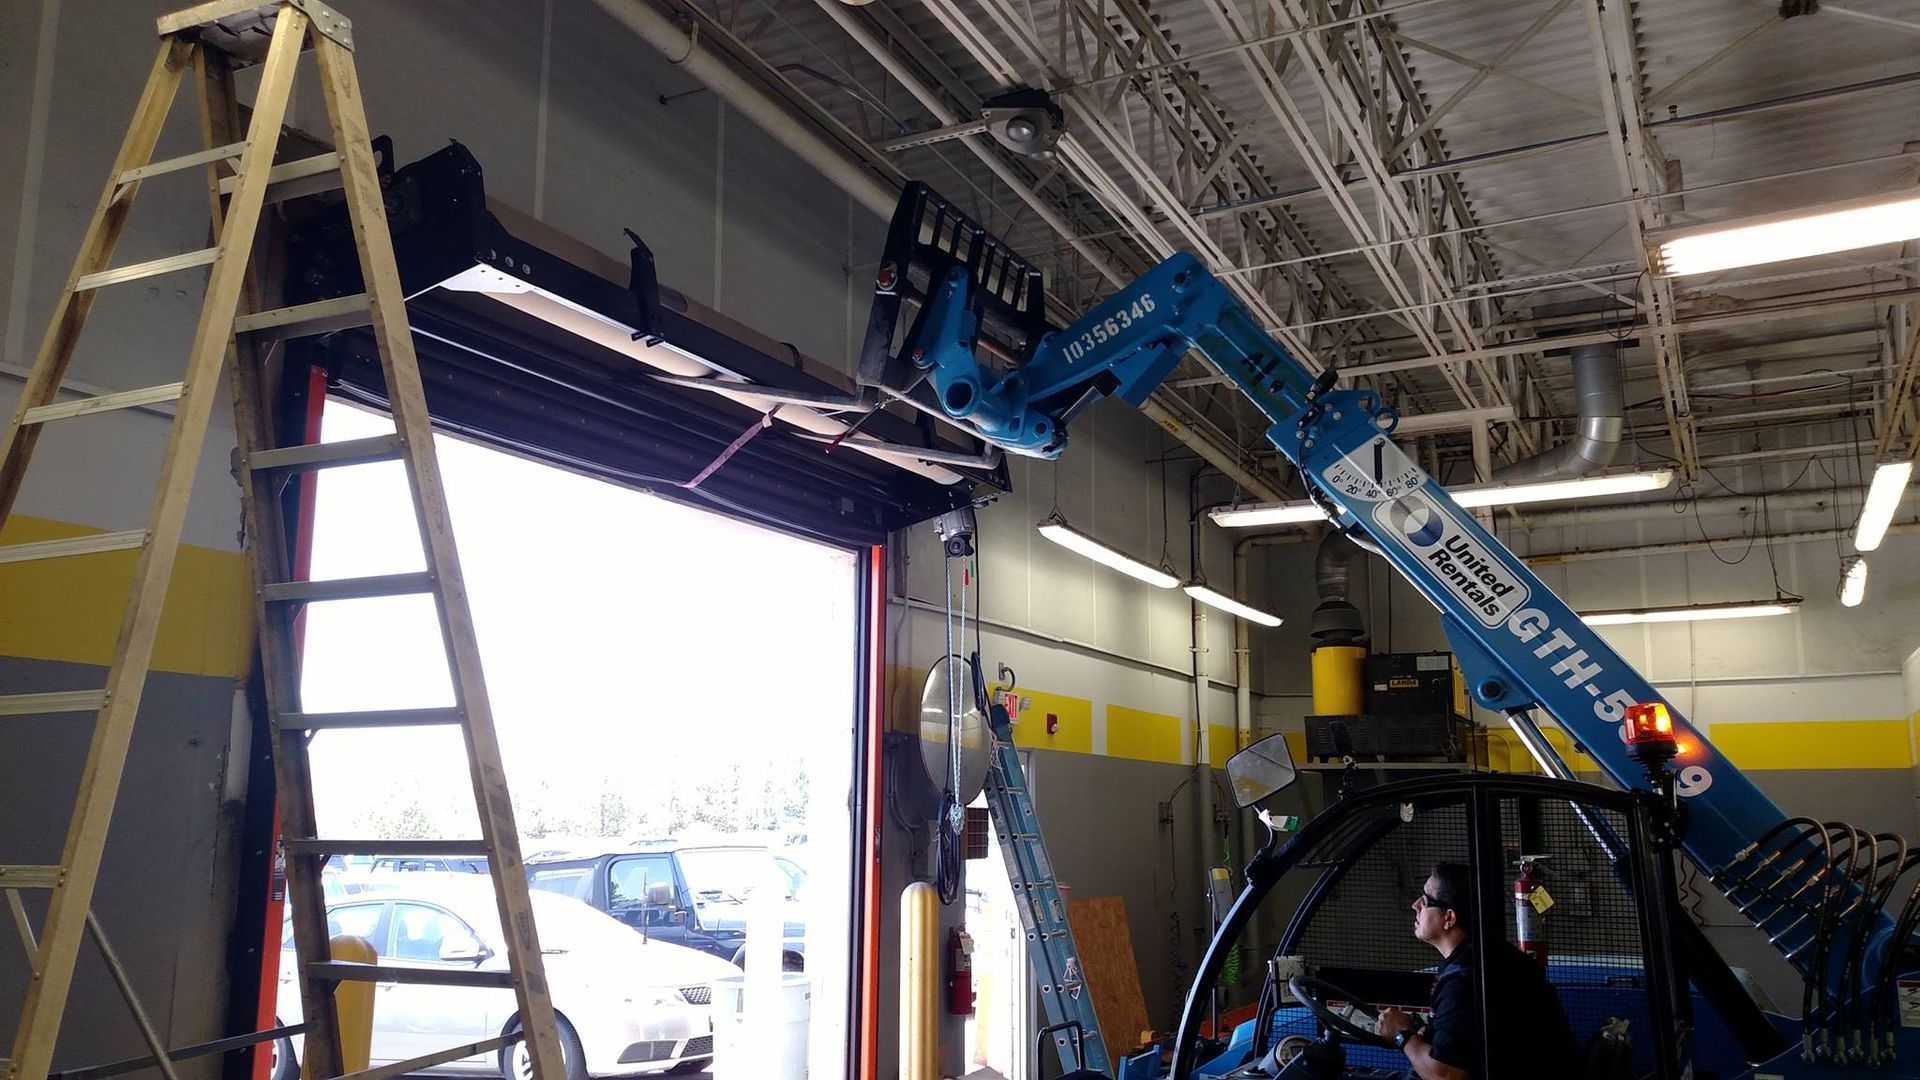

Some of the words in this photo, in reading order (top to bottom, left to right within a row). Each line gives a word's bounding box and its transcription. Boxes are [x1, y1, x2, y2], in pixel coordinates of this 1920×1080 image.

[1062, 293, 1156, 365] 10356346
[1428, 549, 1500, 617] Rentals
[1445, 535, 1515, 598] United
